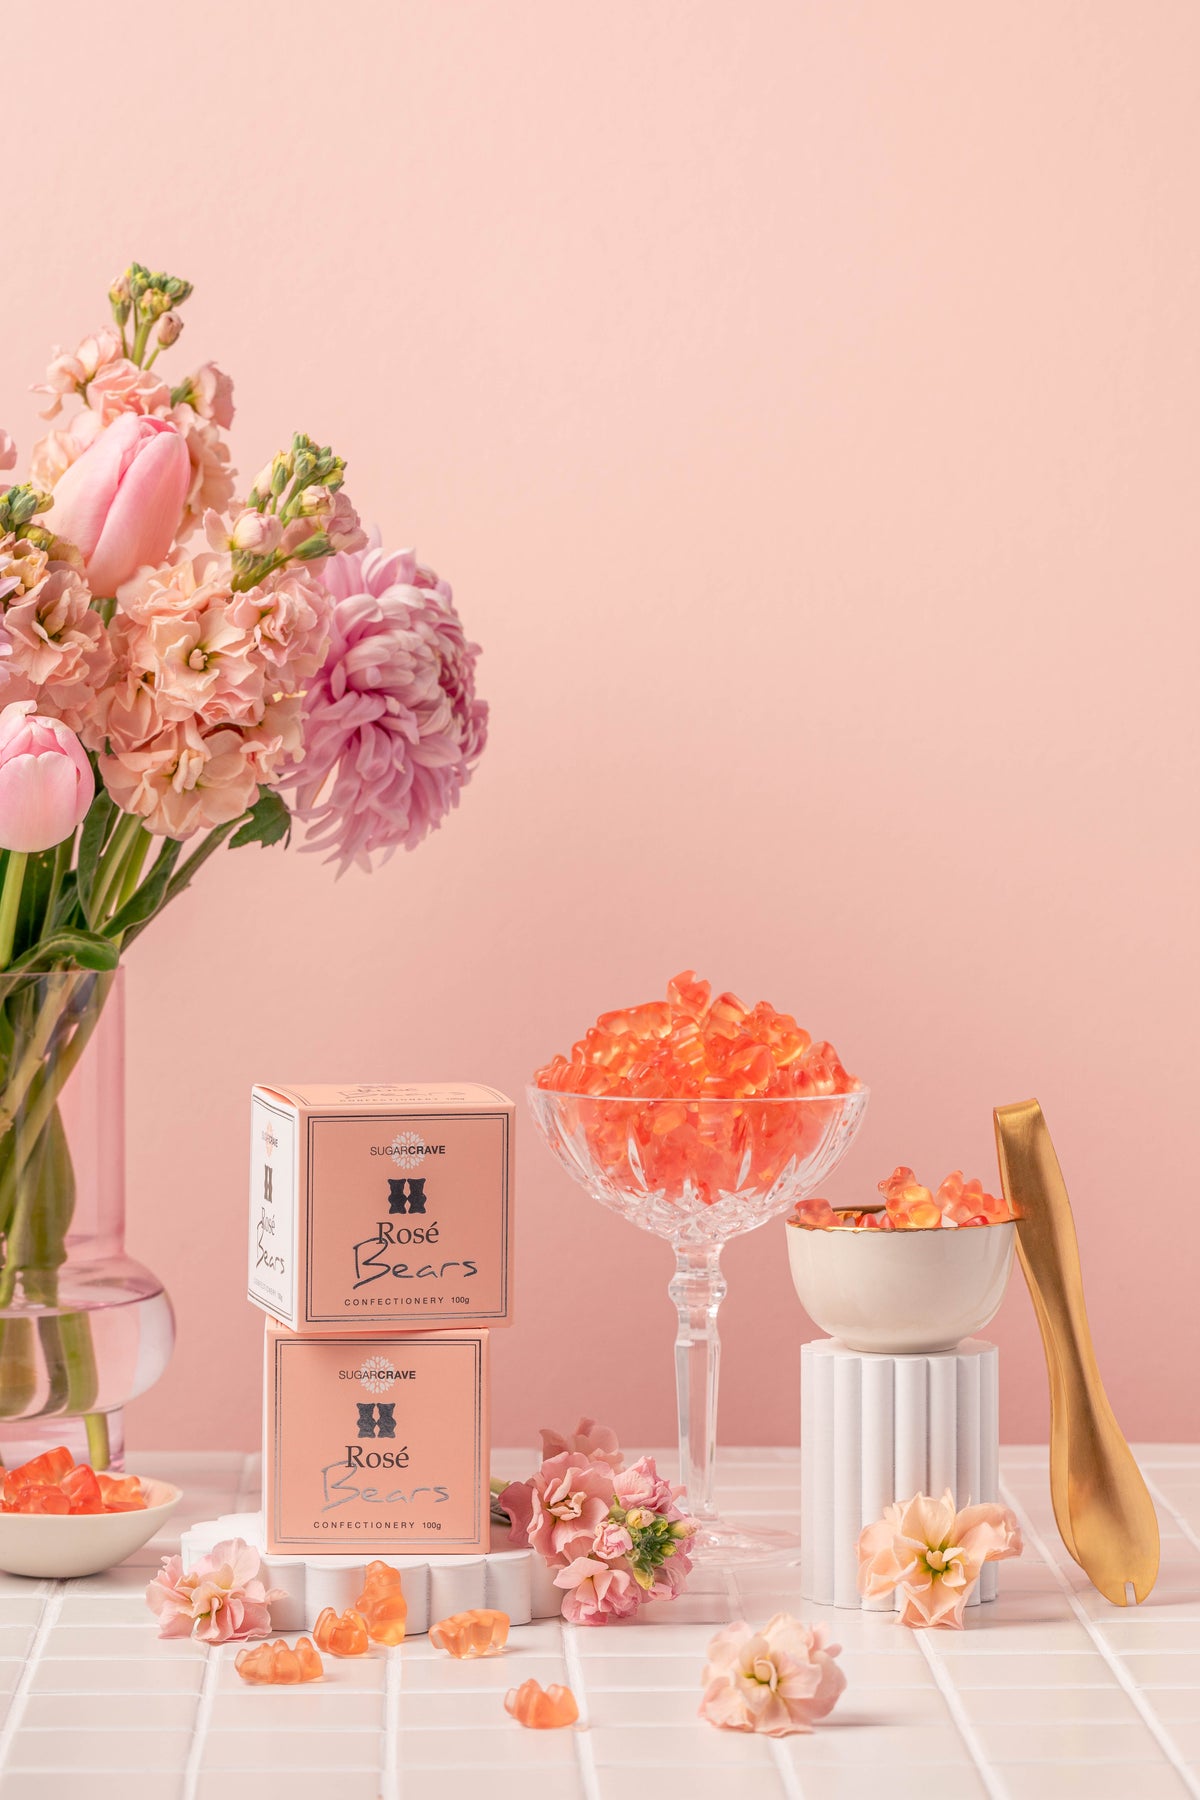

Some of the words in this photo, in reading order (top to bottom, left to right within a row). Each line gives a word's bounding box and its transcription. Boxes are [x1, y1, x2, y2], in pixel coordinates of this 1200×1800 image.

[370, 1145, 446, 1156] SUGARCRAVE
[261, 1206, 275, 1236] Rosé
[376, 1221, 440, 1245] Rosé
[255, 1219, 285, 1275] Bears
[352, 1237, 478, 1291] Bears
[344, 1297, 444, 1307] CONFECTIONERY
[450, 1296, 470, 1306] 100g
[338, 1370, 417, 1381] SUGARCRAVE
[345, 1445, 410, 1469] Rosé
[321, 1460, 450, 1513] Bears
[313, 1521, 415, 1530] CONFECTIONERY
[422, 1521, 442, 1531] 100g
